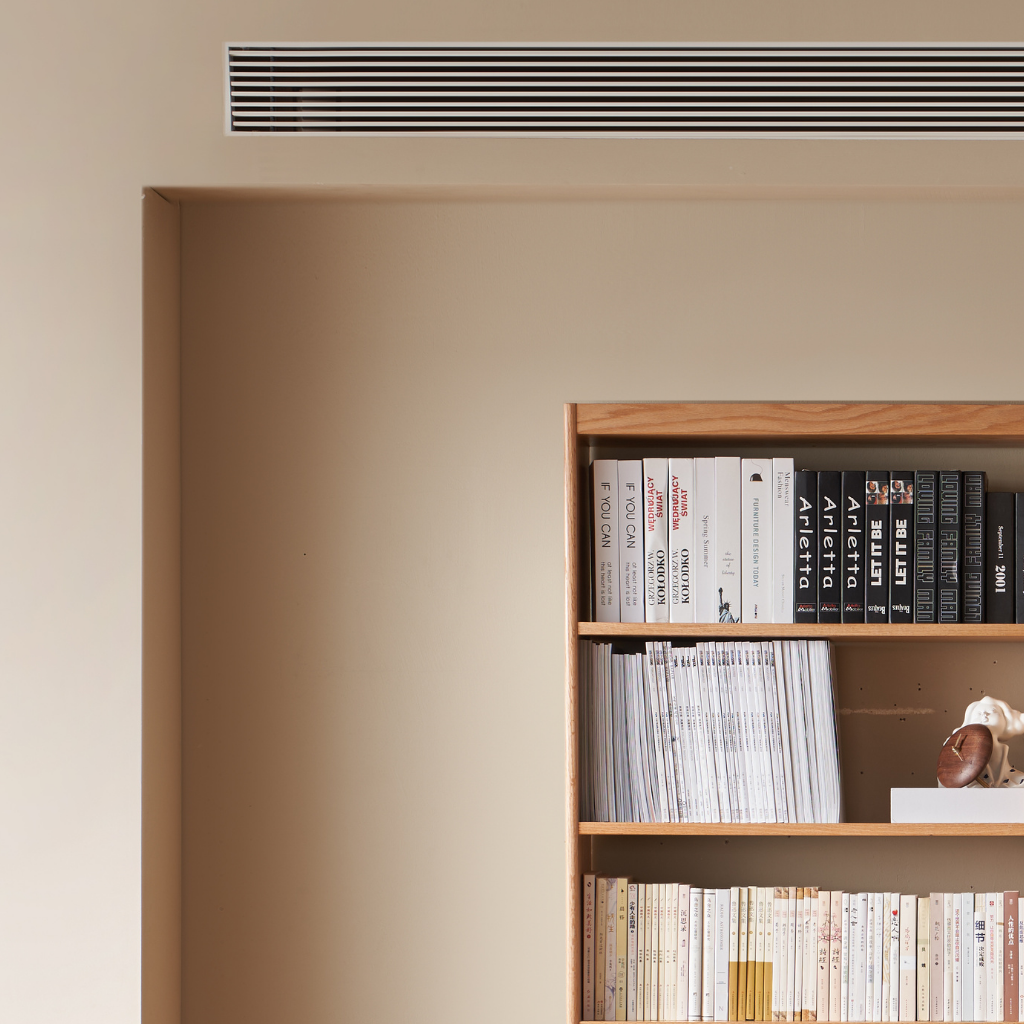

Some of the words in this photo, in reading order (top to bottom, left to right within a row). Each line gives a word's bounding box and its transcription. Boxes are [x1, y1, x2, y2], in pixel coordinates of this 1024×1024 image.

[600, 482, 612, 492] IF
[626, 482, 636, 492] IF
[917, 474, 934, 524] LOVING
[941, 474, 958, 524] LOVING
[964, 474, 982, 508] MAN
[600, 497, 612, 520] YOU
[626, 497, 636, 520] YOU
[656, 490, 664, 518] ŚWIAT
[672, 476, 680, 530] WĘDRUJĄCY
[680, 488, 688, 517] ŚWIAT
[600, 524, 612, 548] CAN
[626, 524, 636, 549] CAN
[799, 496, 814, 589] Arletta
[823, 496, 838, 588] Arletta
[847, 496, 862, 588] Arletta
[870, 520, 882, 539] BE
[895, 519, 907, 538] BE
[964, 514, 982, 566] FAMILY
[870, 543, 882, 556] IT
[895, 542, 907, 556] IT
[917, 530, 934, 582] FAMILY
[941, 530, 958, 583] FAMILY
[656, 550, 666, 605] KOŁODKO
[681, 548, 690, 604] KOŁODKO
[870, 559, 882, 586] LET
[895, 559, 907, 585] LET
[995, 565, 1006, 593] 2001
[917, 589, 934, 622] MAN
[941, 589, 958, 622] MAN
[975, 920, 986, 943] 细节
